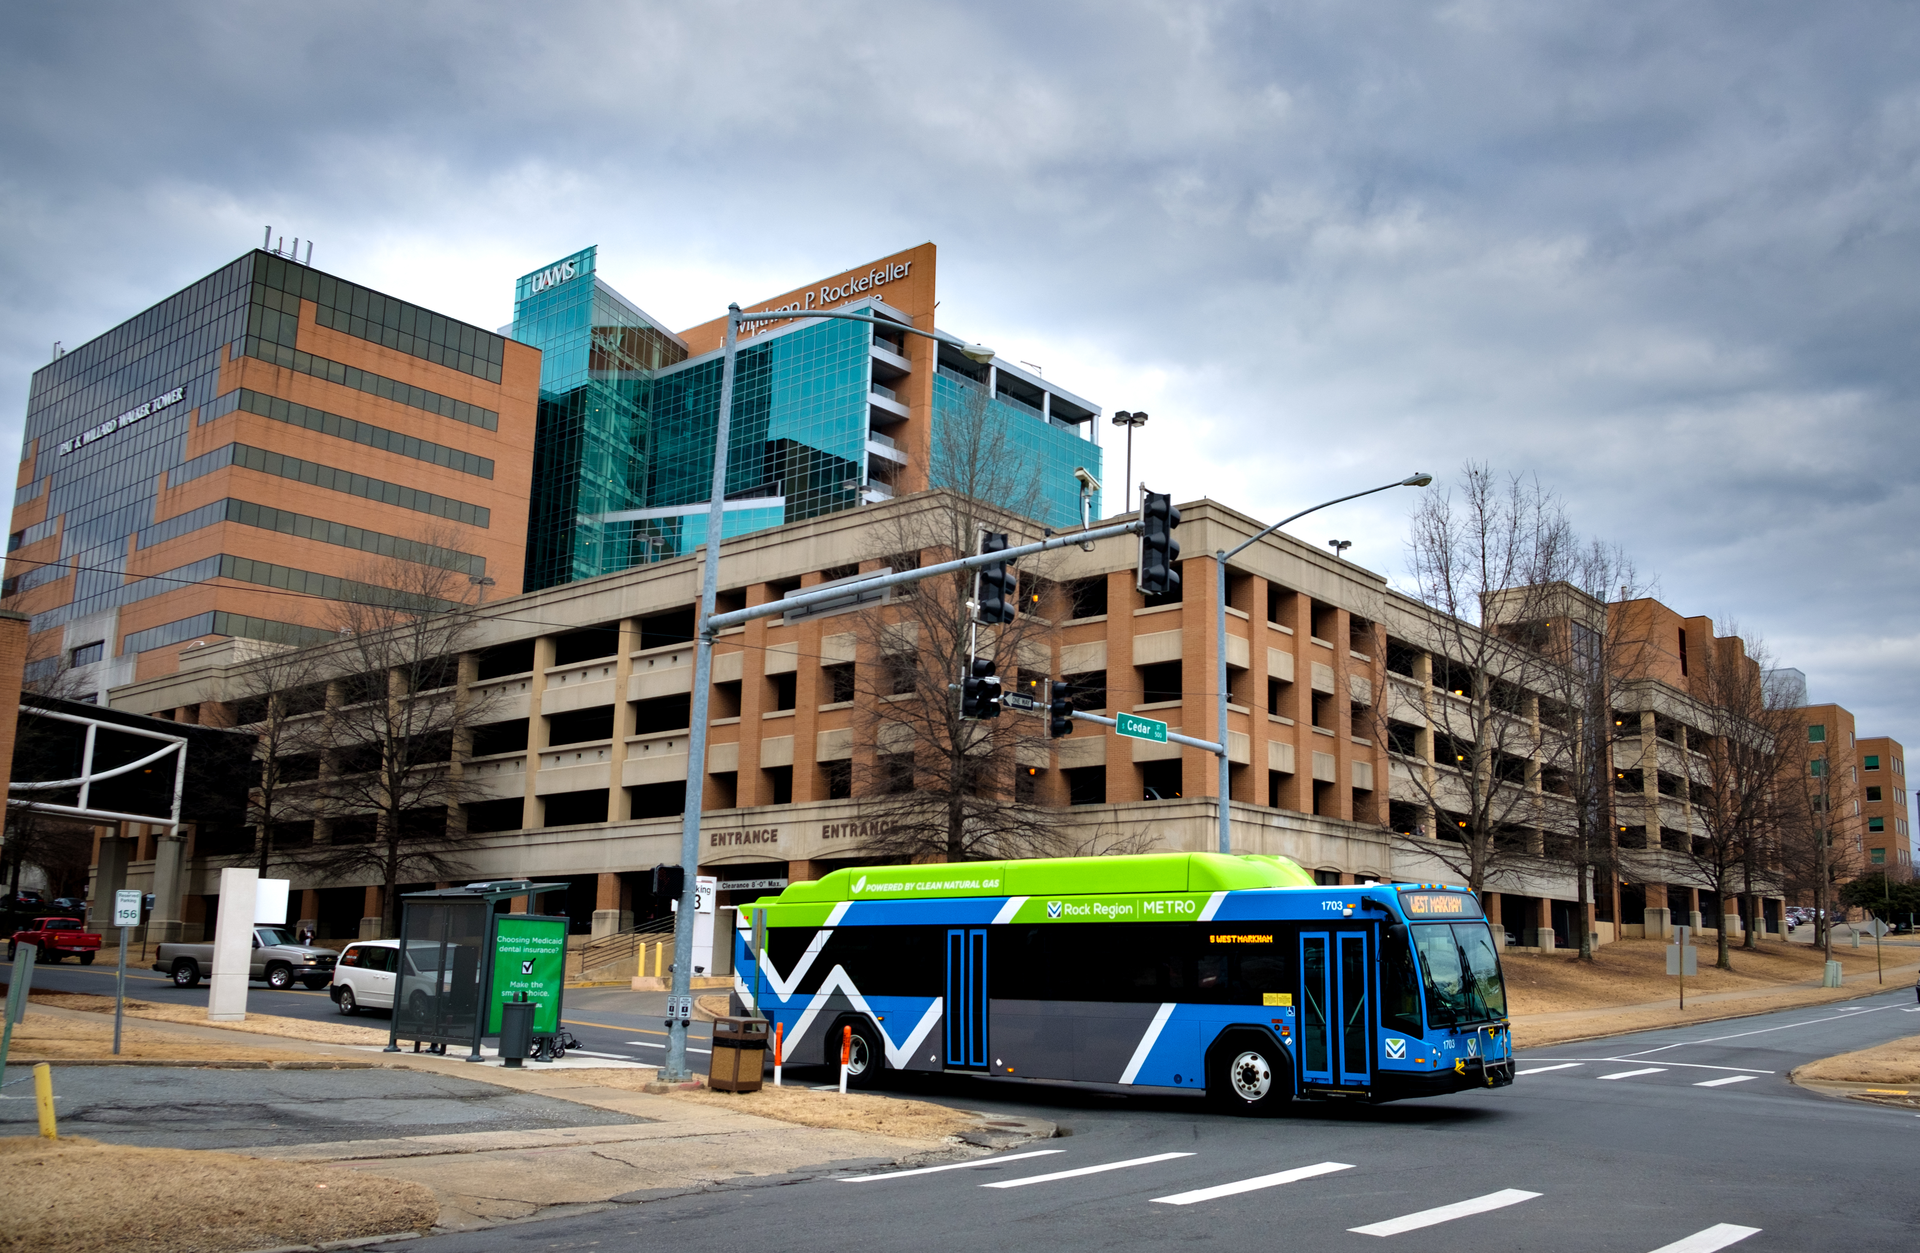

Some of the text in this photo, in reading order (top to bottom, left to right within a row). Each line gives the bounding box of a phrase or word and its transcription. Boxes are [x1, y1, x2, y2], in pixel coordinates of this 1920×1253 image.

[531, 259, 576, 293] UAMS
[805, 291, 816, 311] P.
[820, 260, 912, 305] Rockefeller
[82, 419, 118, 445] WILLARD
[118, 402, 151, 429] WALKER
[150, 387, 184, 413] TOWER
[1012, 696, 1031, 707] ONE WAY
[1127, 719, 1151, 735] Cedar
[1154, 730, 1163, 739] 500
[710, 828, 778, 847] ENTRANCE
[695, 885, 712, 896] king
[721, 882, 750, 890] Clearance
[865, 879, 1000, 892] POWERED BY CLEAN NATURAL GAS
[1064, 900, 1196, 919] Rock Region METRO
[1321, 901, 1343, 911] 1703
[1410, 895, 1463, 914] WEST MARKHAM
[118, 909, 137, 919] 156
[496, 935, 563, 945] Choosing Medicaid
[1216, 934, 1237, 944] WEST
[1237, 934, 1273, 944] MARKHAM
[522, 946, 559, 954] insurance?
[509, 980, 529, 988] Make
[1443, 1039, 1456, 1050] 1703
